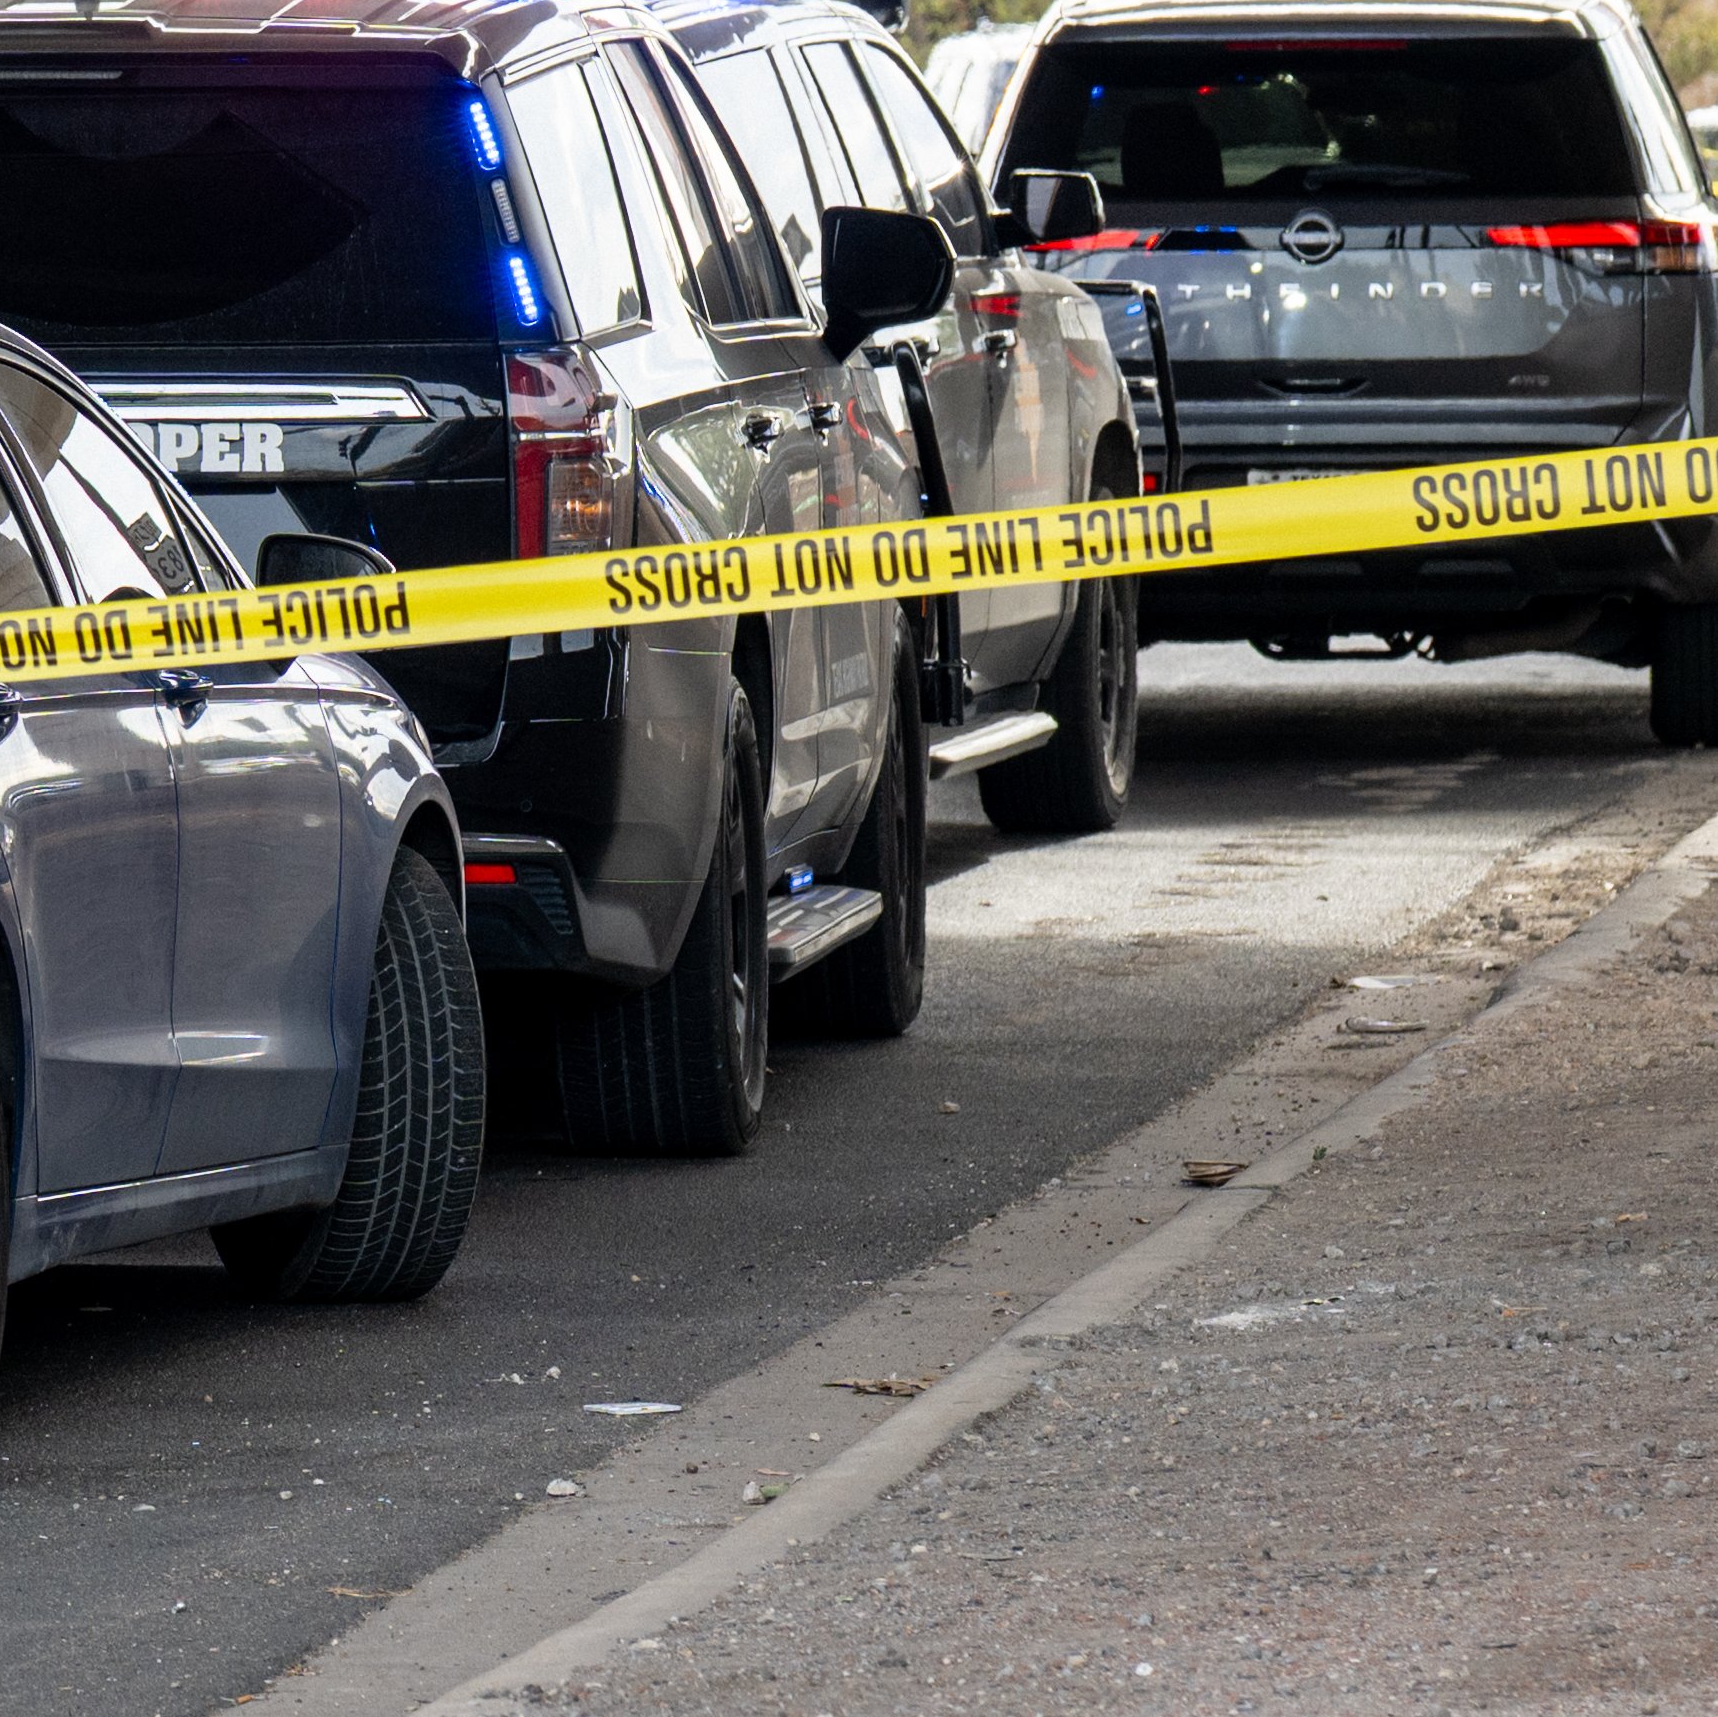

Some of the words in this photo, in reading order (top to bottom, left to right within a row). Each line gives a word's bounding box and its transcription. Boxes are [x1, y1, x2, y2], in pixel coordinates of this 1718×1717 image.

[1413, 462, 1562, 533] CROSS
[1581, 451, 1667, 515] NOT
[770, 535, 853, 597] NOT
[872, 527, 932, 587] DO
[946, 516, 1044, 581] LINE
[1059, 499, 1214, 569] POLICE
[605, 545, 751, 615] CROSS
[75, 609, 133, 663] DO
[147, 598, 245, 658] LINE
[259, 580, 411, 648] POLICE
